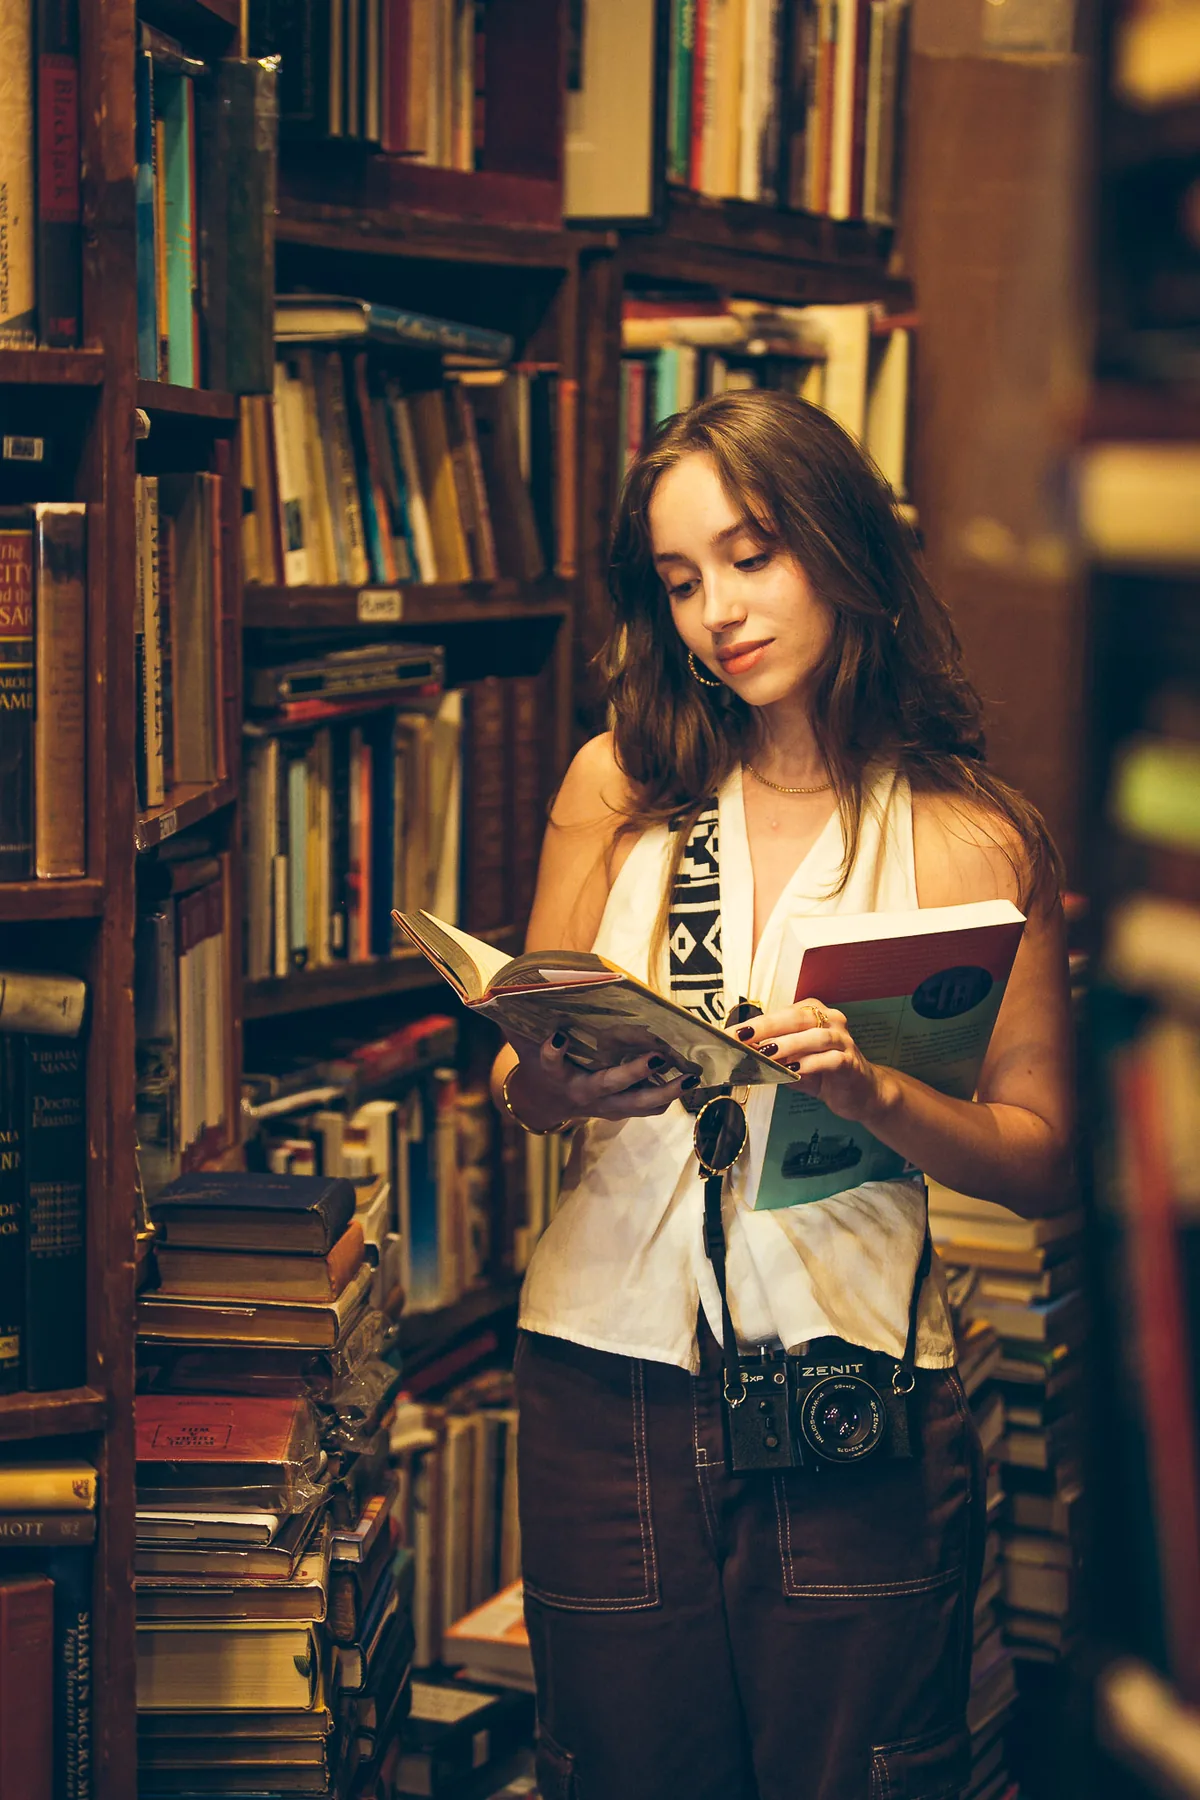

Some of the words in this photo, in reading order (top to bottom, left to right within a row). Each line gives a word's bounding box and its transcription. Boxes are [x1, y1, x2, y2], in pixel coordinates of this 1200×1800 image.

[51, 79, 74, 199] Blackjack
[32, 1111, 82, 1128] Faustu
[801, 1363, 864, 1377] ZENIT
[63, 1629, 77, 1665] Foggy
[65, 1669, 77, 1727] Mountain
[65, 1732, 77, 1799] Breakdown
